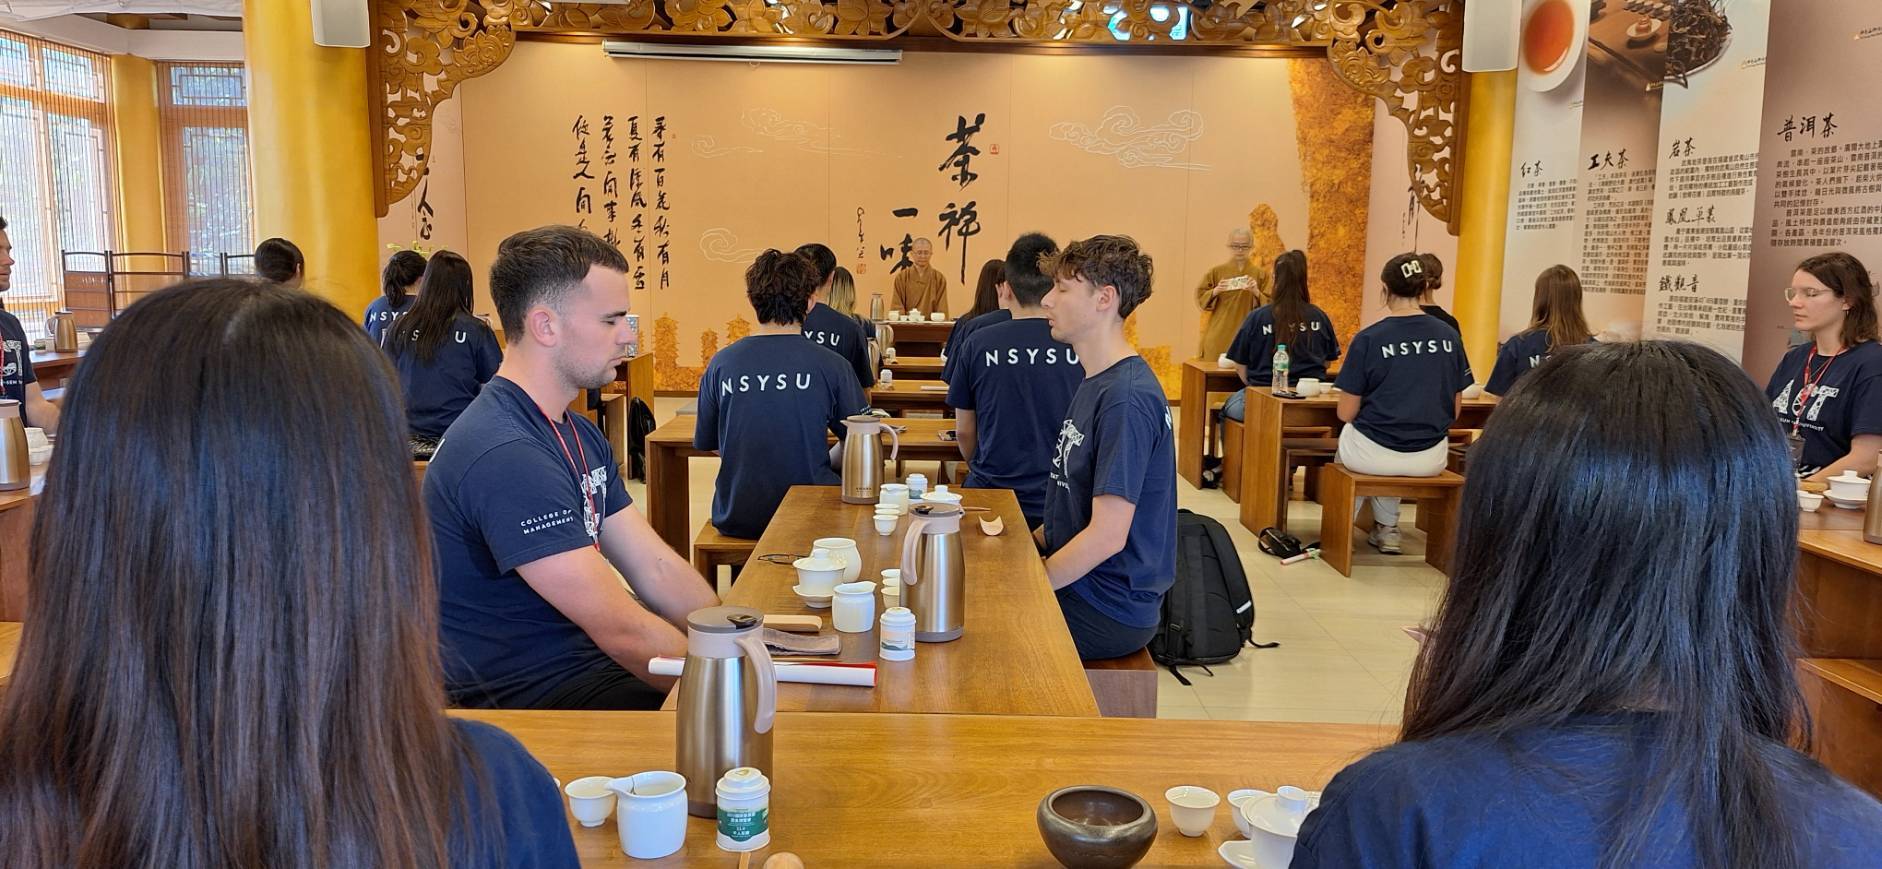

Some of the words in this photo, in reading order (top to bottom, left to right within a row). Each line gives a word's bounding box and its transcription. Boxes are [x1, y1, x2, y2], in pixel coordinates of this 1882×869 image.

[1777, 112, 1838, 142] 普洱茶
[1669, 136, 1697, 159] 岩茶
[1520, 160, 1544, 178] 紅茶
[1587, 148, 1630, 171] 工夫茶
[1659, 273, 1700, 293] 鐵觀音
[985, 347, 1080, 367] NSYSU
[1381, 339, 1453, 359] NSYSU
[721, 373, 811, 397] NSYSU
[520, 511, 559, 527] COLLEGE
